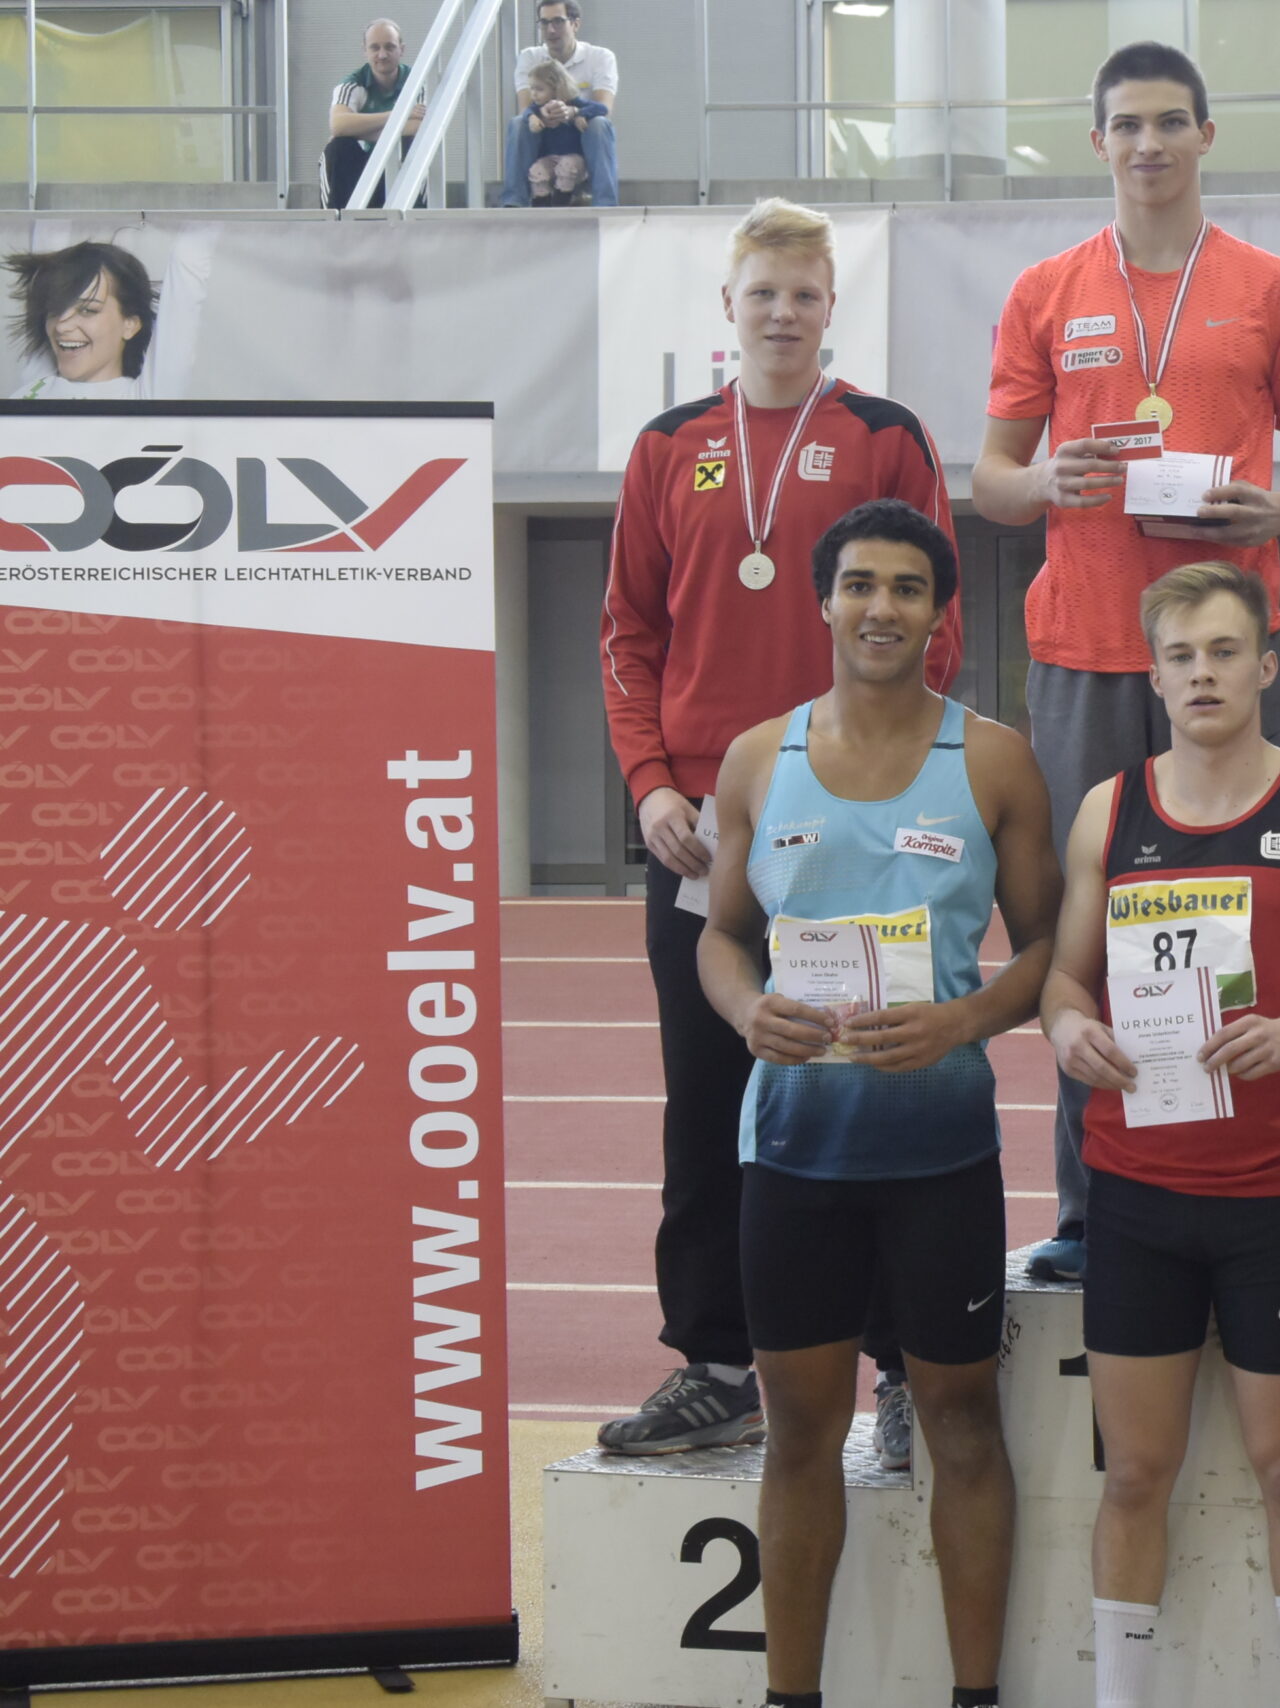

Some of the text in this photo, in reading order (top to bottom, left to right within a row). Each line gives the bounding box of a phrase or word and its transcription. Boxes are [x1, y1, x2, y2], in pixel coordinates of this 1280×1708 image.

[1133, 436, 1153, 446] 2017
[698, 449, 731, 460] erima
[224, 565, 472, 582] LEICHTATHLETIK-VERBAND
[900, 835, 957, 857] Kornspitz
[1134, 854, 1161, 864] erima
[1109, 889, 1248, 921] Wiesbauer
[1152, 928, 1198, 972] 87
[789, 959, 861, 970] URKUNDE
[1121, 1014, 1196, 1031] URKUNDE
[386, 748, 484, 1491] www.ooelv.at
[680, 1516, 767, 1652] 2
